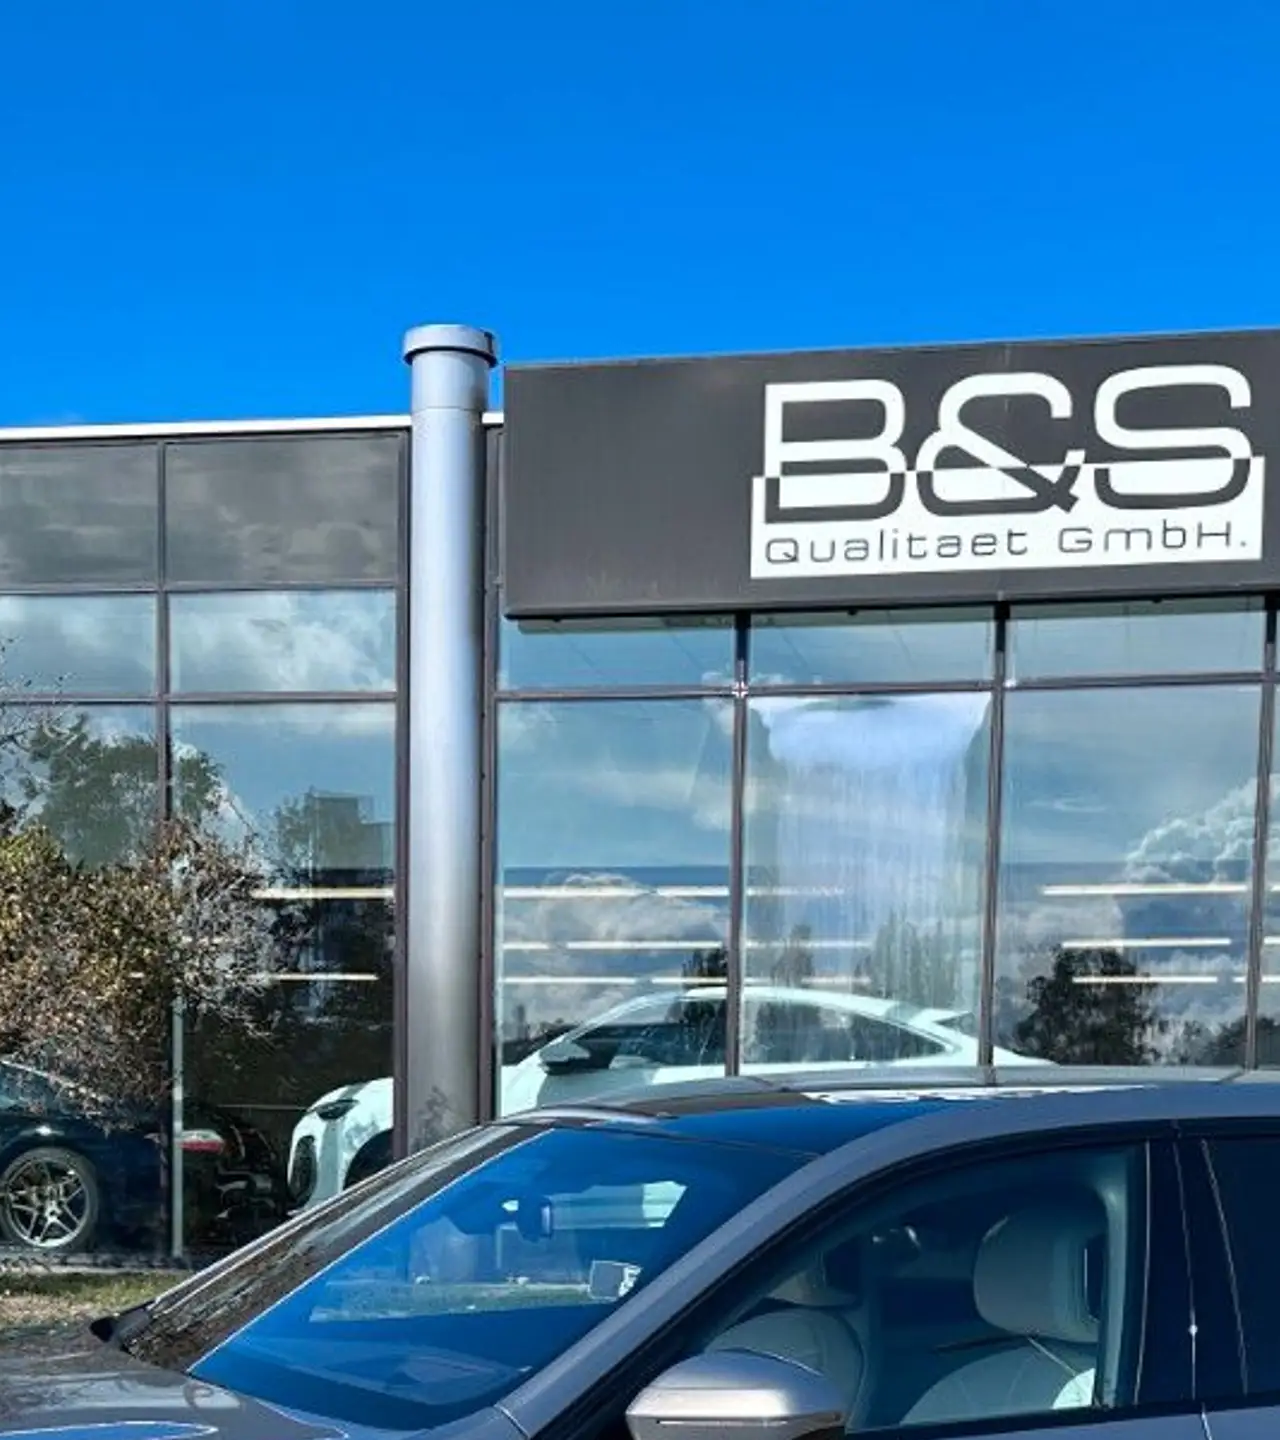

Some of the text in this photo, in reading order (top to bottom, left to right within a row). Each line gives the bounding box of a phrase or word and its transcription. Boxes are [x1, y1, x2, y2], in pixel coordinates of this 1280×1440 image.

[765, 364, 1252, 524] B&S
[765, 519, 1248, 564] Qualitaet GmbH.
